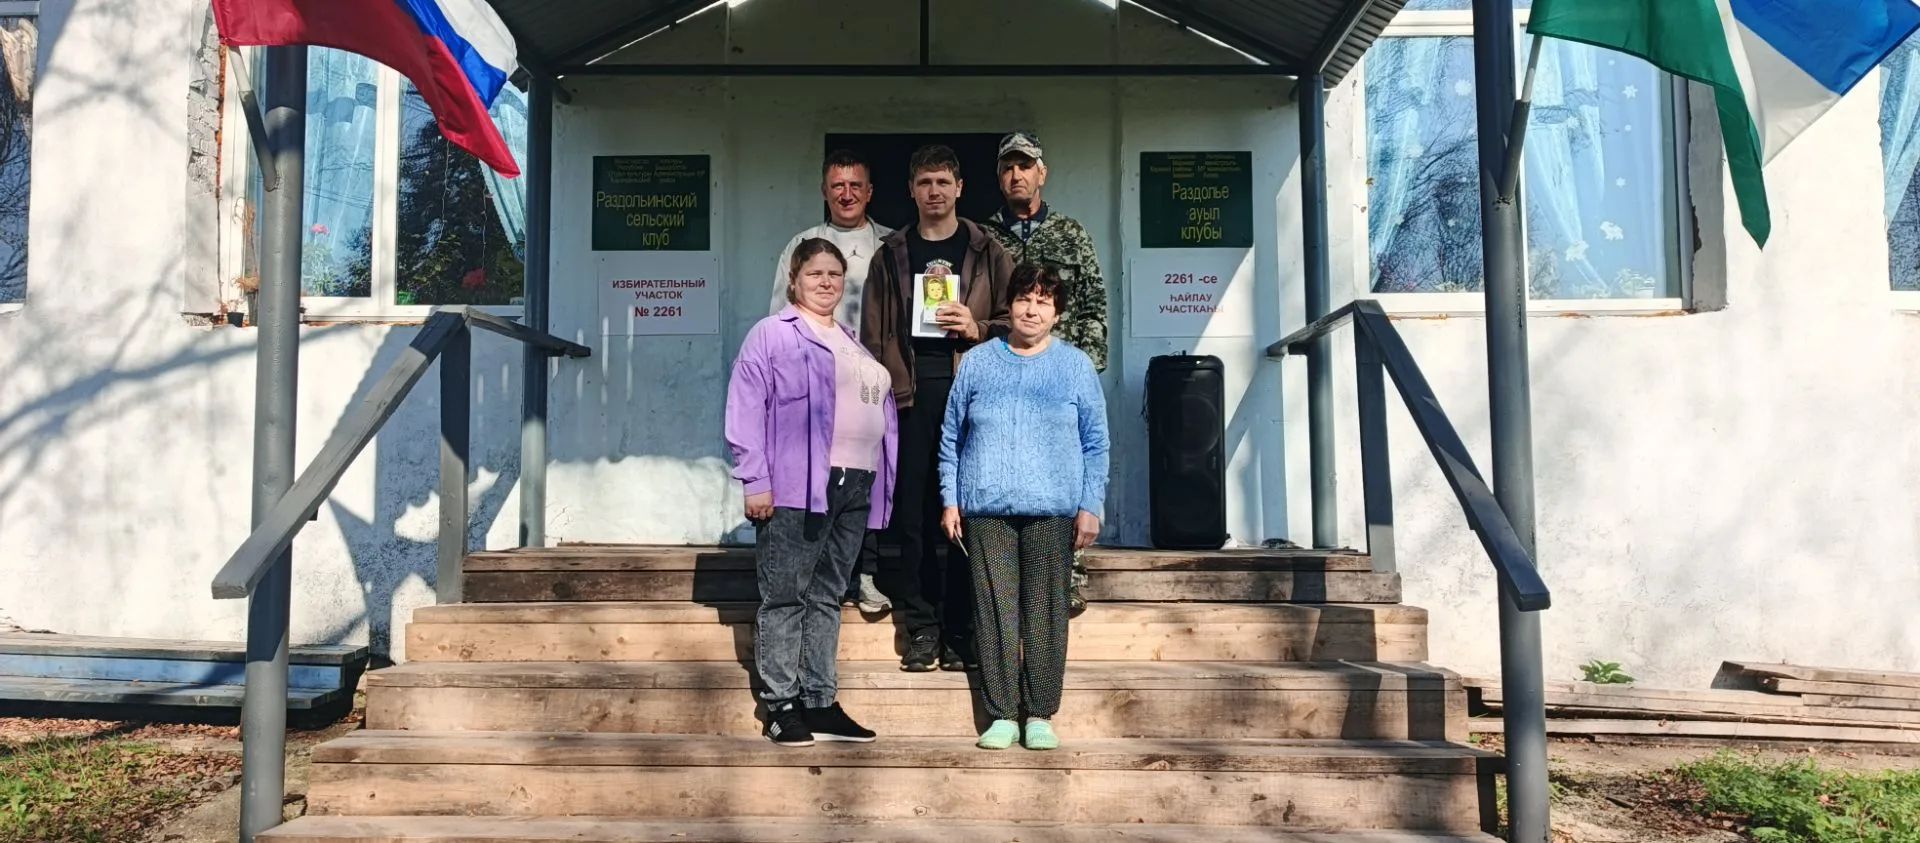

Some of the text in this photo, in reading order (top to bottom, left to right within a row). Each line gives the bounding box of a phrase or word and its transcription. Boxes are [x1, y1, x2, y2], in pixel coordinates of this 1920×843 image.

[1172, 182, 1230, 203] Раздолье
[626, 210, 685, 227] сельский
[1188, 207, 1220, 225] ауыл
[642, 228, 670, 249] клуб
[1181, 222, 1222, 243] клубы
[612, 277, 706, 289] ИЗБИРАТЕЛЬНЫЙ
[1164, 273, 1193, 284] 2261
[635, 290, 683, 300] УЧАСТОК
[634, 306, 682, 317] № 2261
